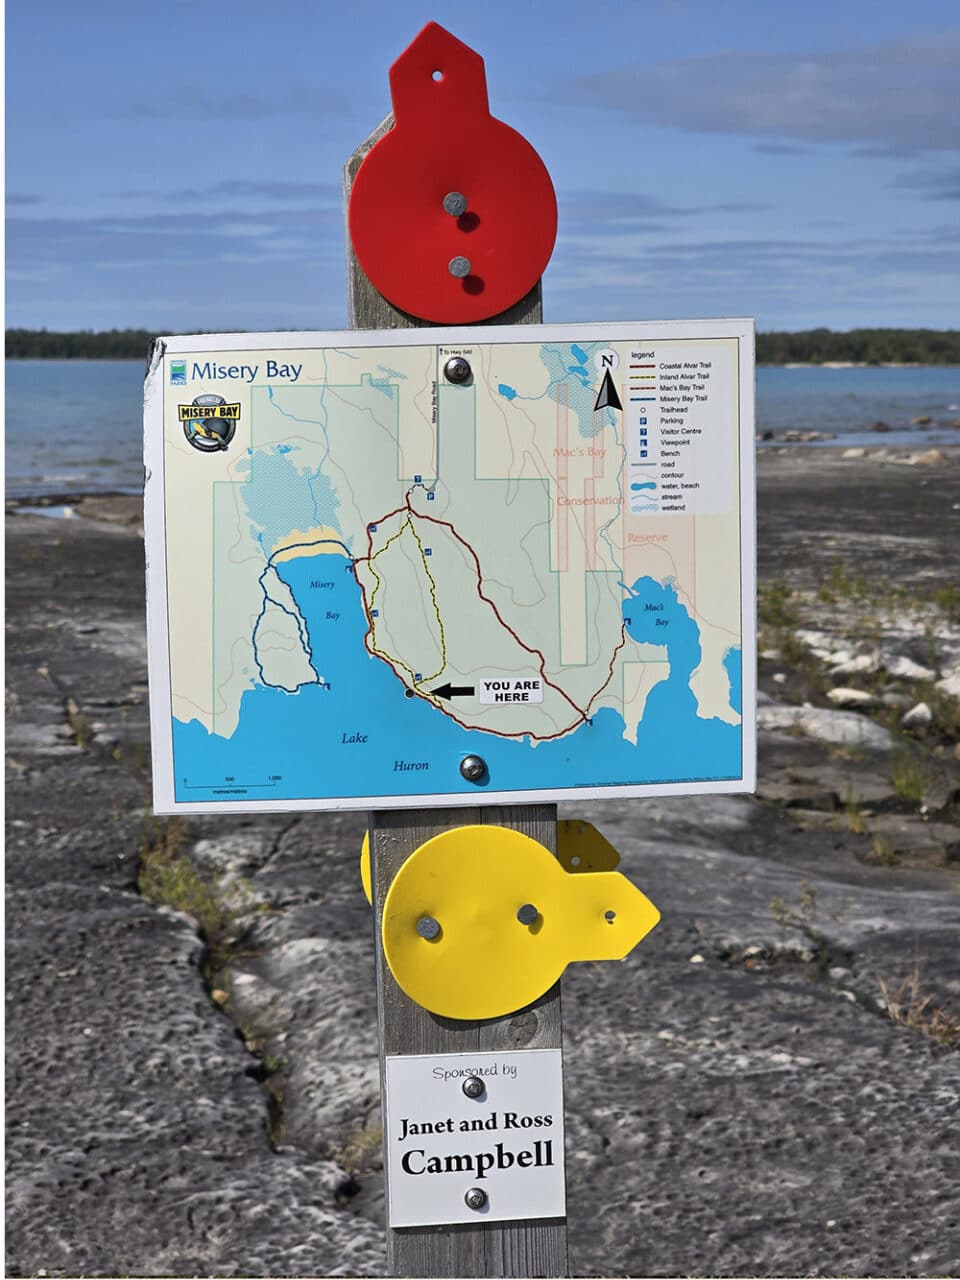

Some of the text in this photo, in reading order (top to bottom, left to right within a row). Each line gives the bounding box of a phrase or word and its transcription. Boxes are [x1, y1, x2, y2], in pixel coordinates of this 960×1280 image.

[602, 355, 613, 367] N
[192, 360, 302, 383] Misery Bay
[182, 407, 237, 417] MISERY BAY
[553, 448, 606, 459] Mac's Bay
[557, 496, 624, 506] Conservation
[628, 533, 668, 542] Reserve
[310, 580, 334, 589] Misery
[644, 603, 664, 611] Mac's
[326, 611, 340, 620] Bay
[656, 618, 669, 627] Bay
[484, 681, 540, 690] YOU ARE
[496, 692, 529, 702] HERE
[342, 732, 368, 744] Lake
[394, 761, 429, 771] Huron
[433, 1064, 518, 1082] Sponsored by
[398, 1112, 553, 1140] Janet and Ross
[402, 1140, 554, 1179] Campbell
